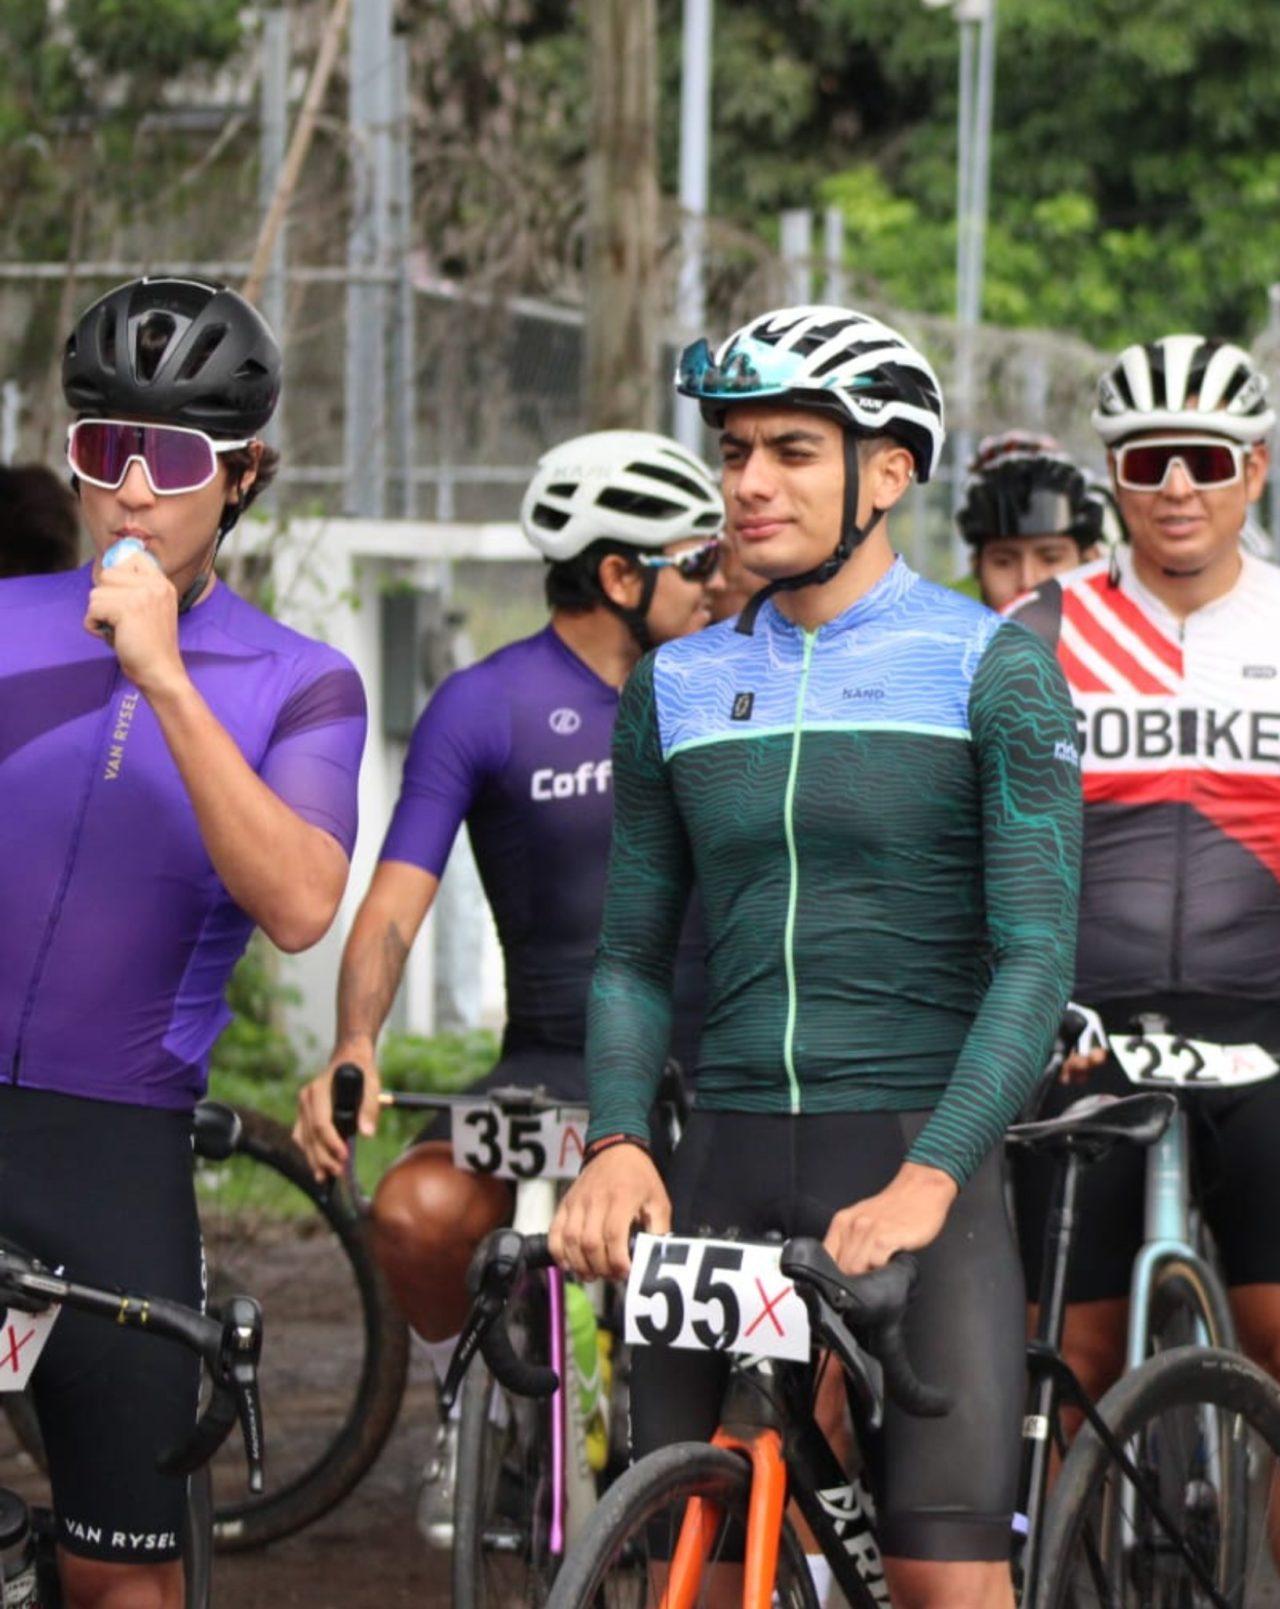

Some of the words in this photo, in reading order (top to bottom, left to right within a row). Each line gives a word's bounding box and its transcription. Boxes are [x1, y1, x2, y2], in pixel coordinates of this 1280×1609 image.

[113, 692, 141, 742] RYSEL
[104, 744, 124, 781] VAN
[531, 759, 613, 801] Coff
[1125, 1037, 1221, 1086] 22
[465, 1109, 546, 1178] 35
[635, 1242, 744, 1351] 55
[65, 1518, 102, 1544] VAN
[112, 1531, 175, 1550] RYSEL
